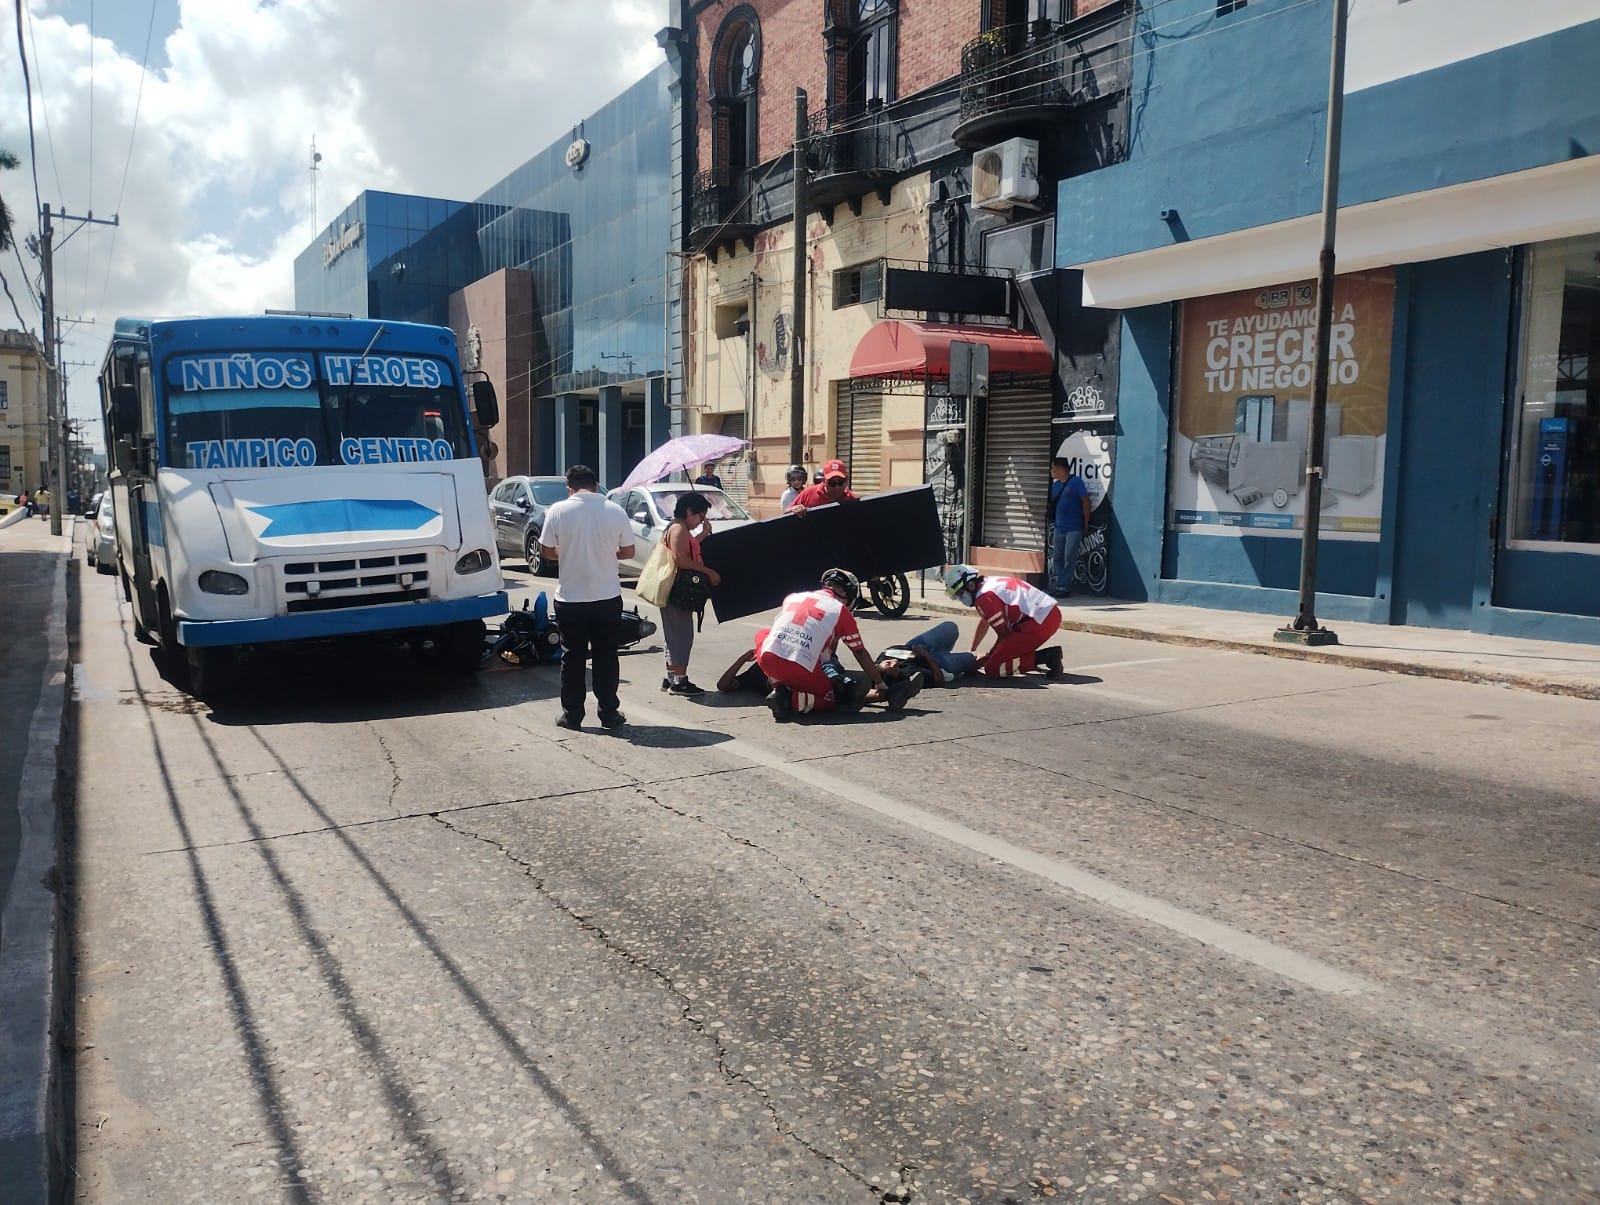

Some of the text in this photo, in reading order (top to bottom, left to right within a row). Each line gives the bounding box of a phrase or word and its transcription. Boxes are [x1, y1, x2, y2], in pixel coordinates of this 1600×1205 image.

[1207, 318, 1229, 337] TE
[1341, 303, 1355, 321] A
[1206, 323, 1355, 370] CRECER
[181, 353, 442, 391] NIÑOS HEROES
[1204, 359, 1360, 393] TU NEGOIO
[186, 437, 454, 469] TAMPICO CENTRO
